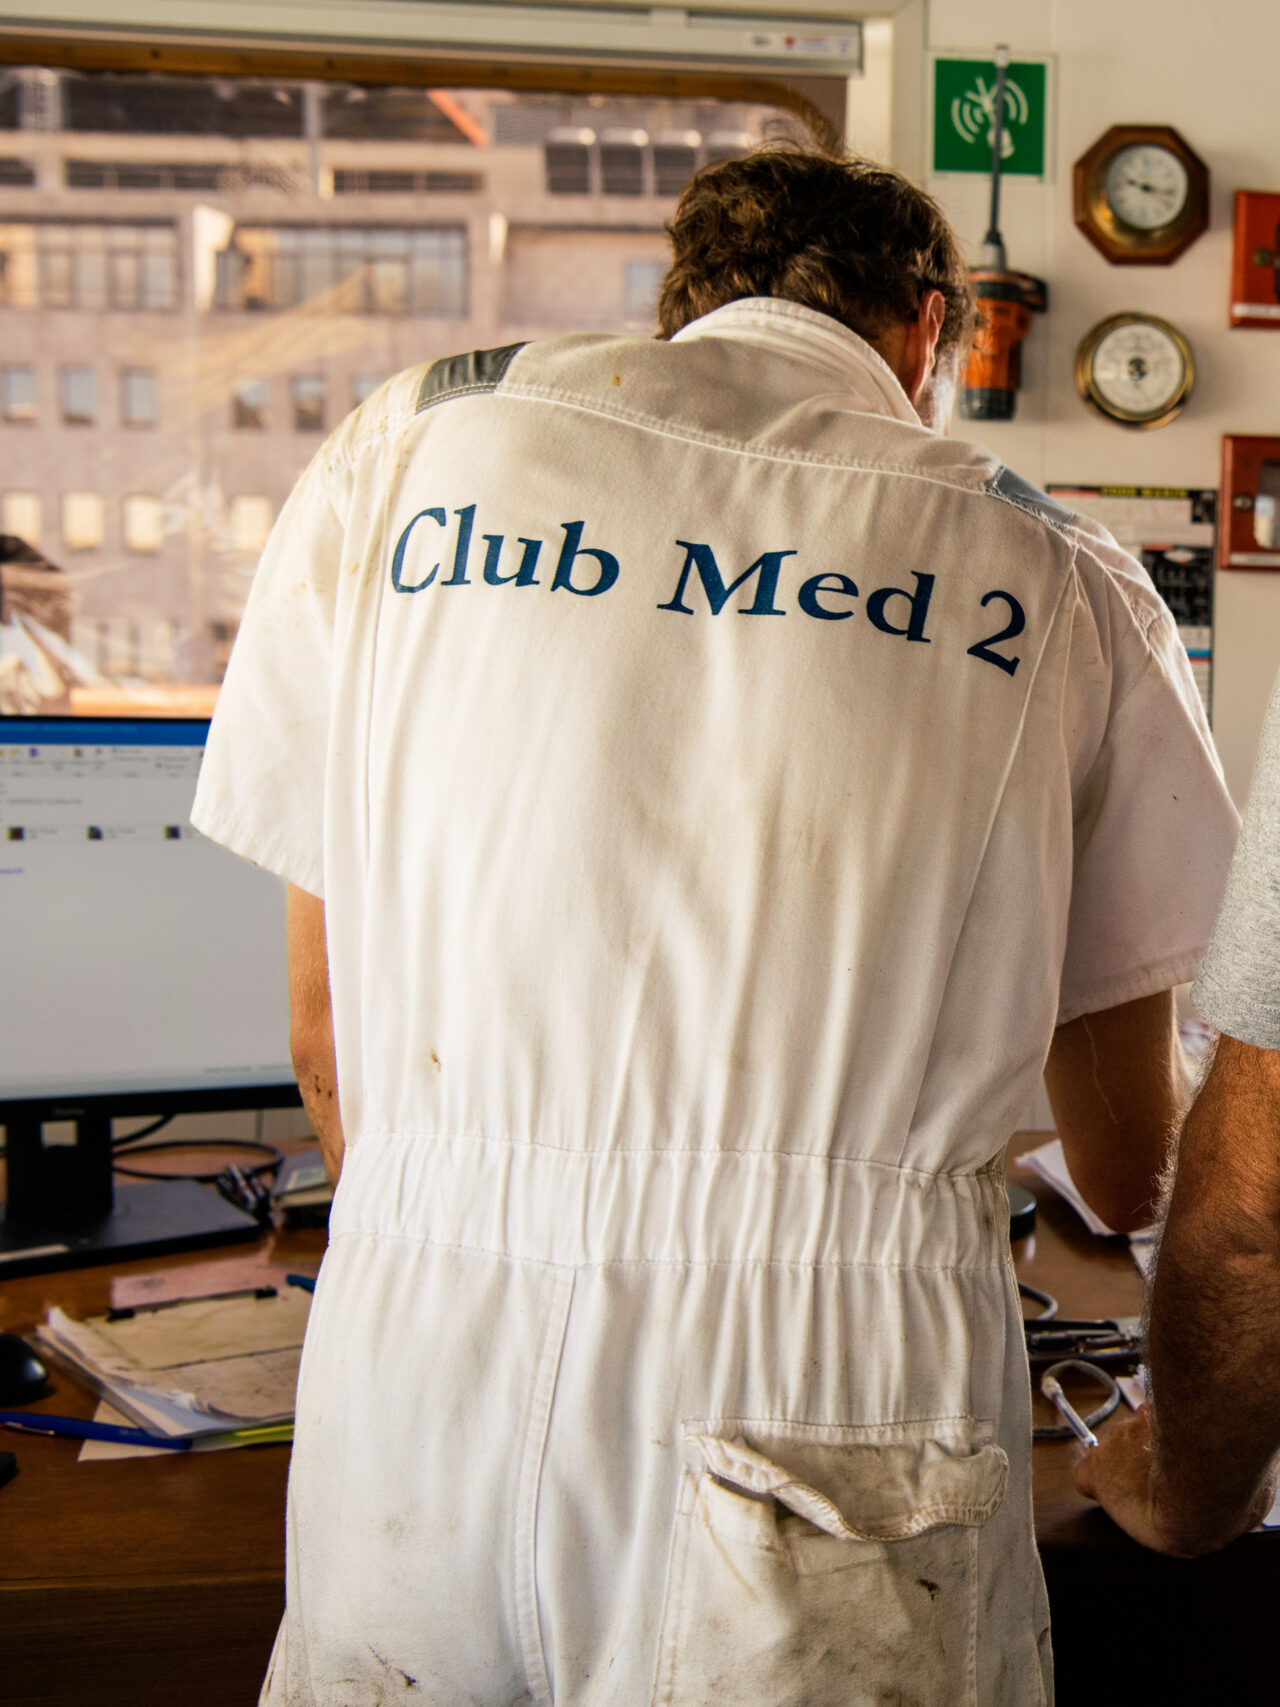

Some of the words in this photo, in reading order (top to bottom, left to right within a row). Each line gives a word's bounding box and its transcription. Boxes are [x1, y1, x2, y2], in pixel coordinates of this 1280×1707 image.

[391, 503, 620, 597] Club
[656, 538, 936, 645] Med
[966, 589, 1026, 677] 2
